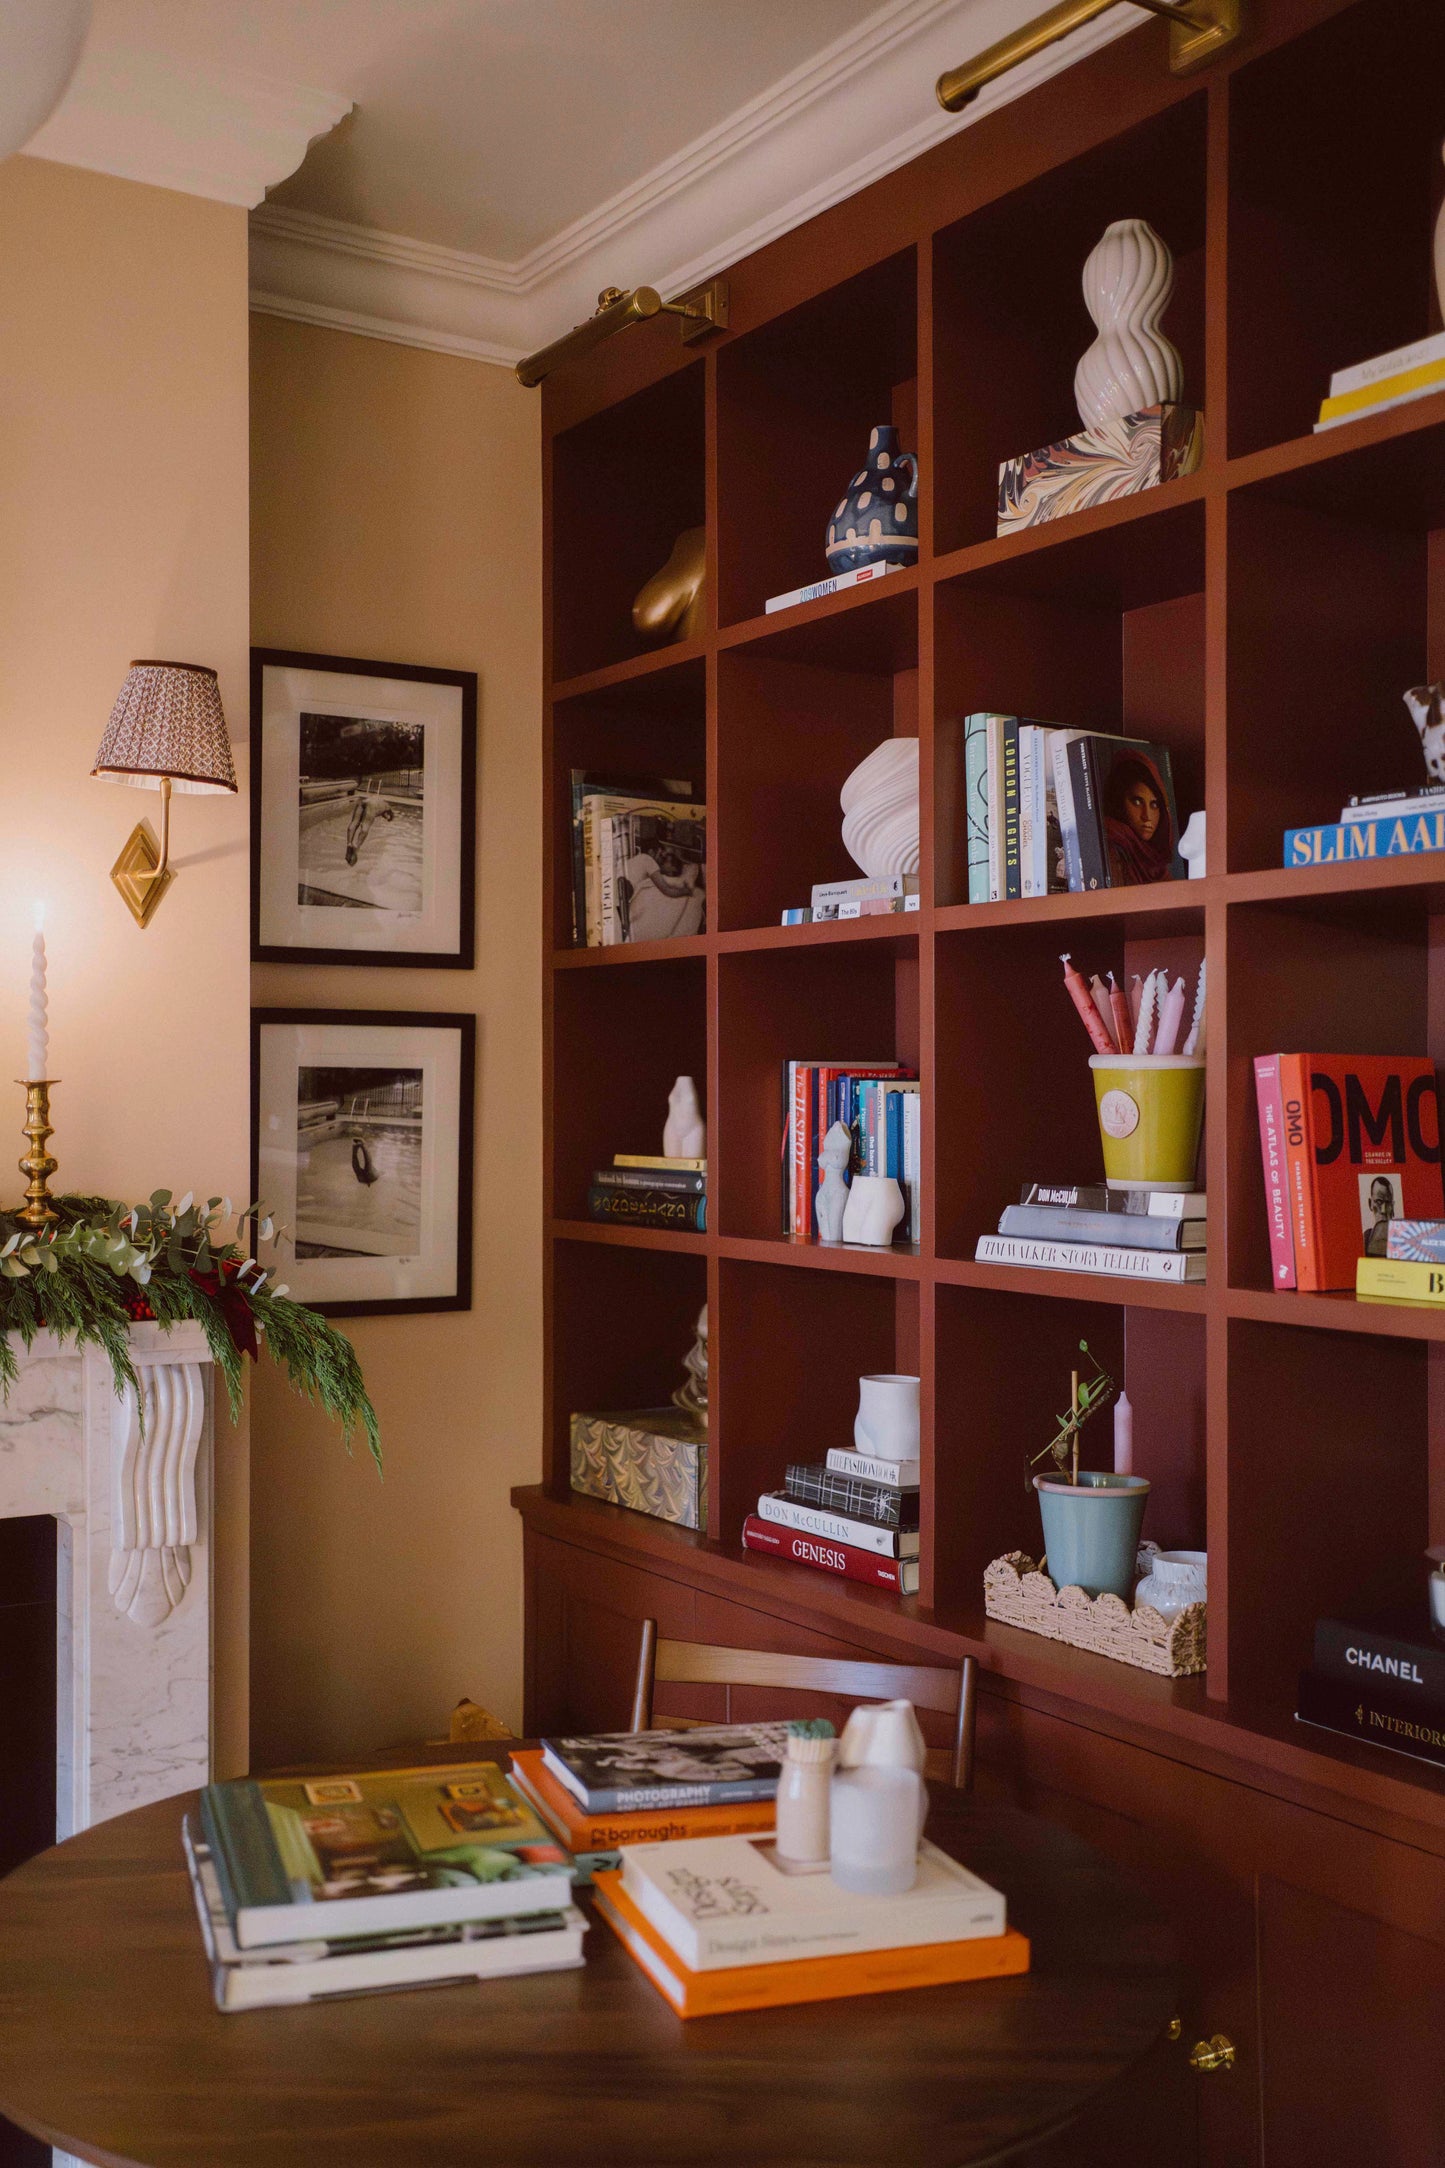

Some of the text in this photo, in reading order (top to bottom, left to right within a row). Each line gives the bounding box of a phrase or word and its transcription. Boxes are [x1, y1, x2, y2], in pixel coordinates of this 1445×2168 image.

[1005, 739, 1018, 866] LONDON NIGHTS
[1054, 747, 1071, 824] Julia Samuel
[1292, 823, 1377, 866] SLIM
[1286, 1100, 1304, 1147] OMO
[1311, 1073, 1441, 1166] OMO
[1265, 1104, 1285, 1239] THE ATLAS OF BEAUTY
[1037, 1188, 1050, 1202] DON
[1297, 1193, 1302, 1201] IN
[984, 1240, 1150, 1272] TIM WALKER STORY TELLER
[765, 1503, 788, 1521] DON
[793, 1511, 849, 1538] McCULLIN
[791, 1539, 846, 1570] GENESIS
[1345, 1647, 1423, 1684] CHANEL
[616, 1785, 711, 1804] PHOTOGRAPHY
[608, 1822, 688, 1843] boroughs
